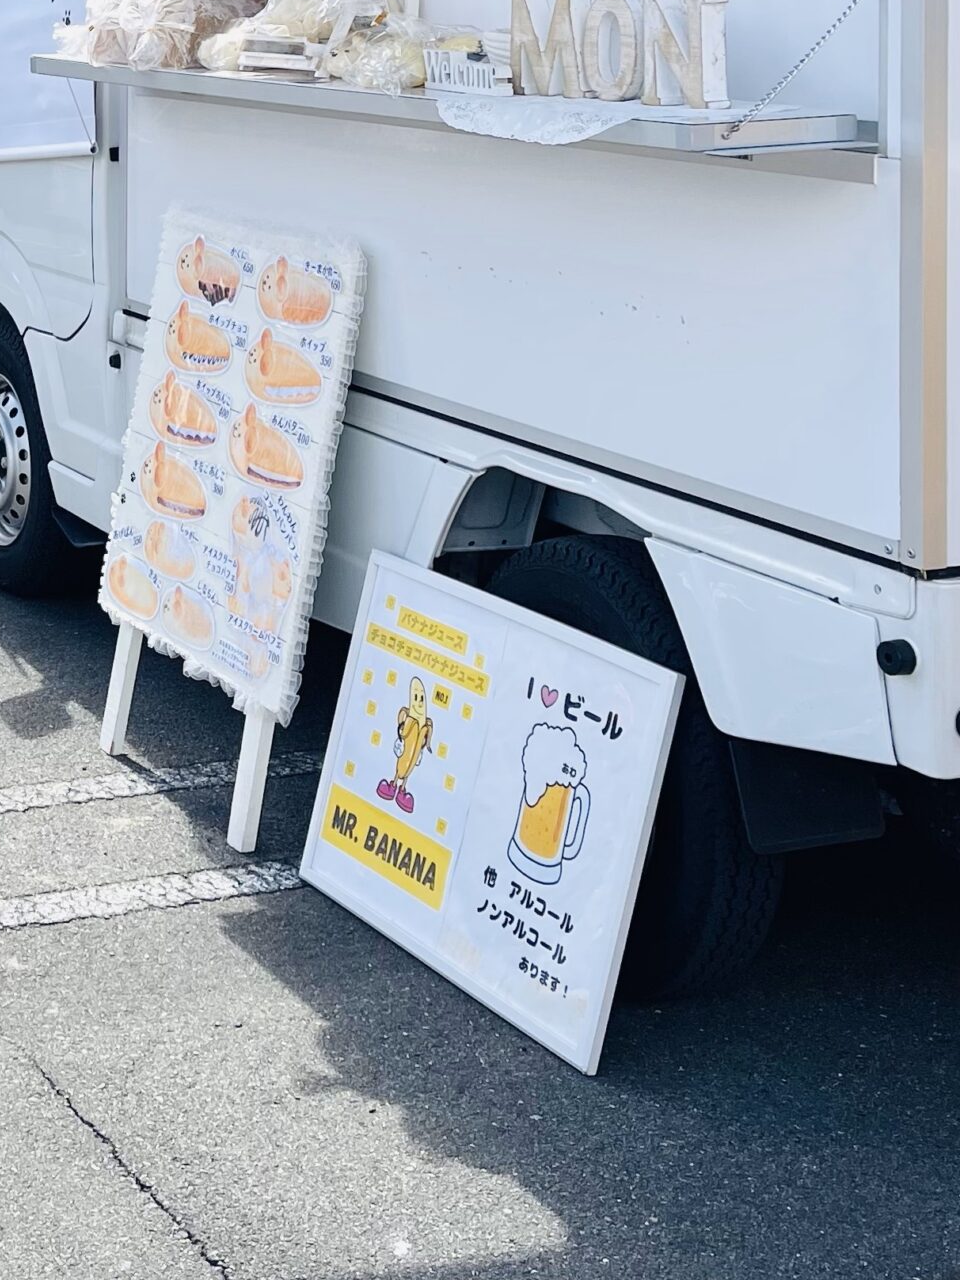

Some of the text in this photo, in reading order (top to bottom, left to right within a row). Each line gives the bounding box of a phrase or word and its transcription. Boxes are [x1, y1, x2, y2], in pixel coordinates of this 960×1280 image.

[423, 49, 497, 89] Welcome
[299, 335, 328, 354] ホイップ
[369, 628, 487, 693] チョコチョコバナナジュース
[400, 613, 465, 651] バナナジュース
[526, 676, 623, 741] I ビール
[331, 804, 438, 892] MR. BANANA
[476, 897, 567, 966] ノンアルコール
[482, 865, 575, 935] 他 アルコール
[517, 955, 570, 999] あります!
